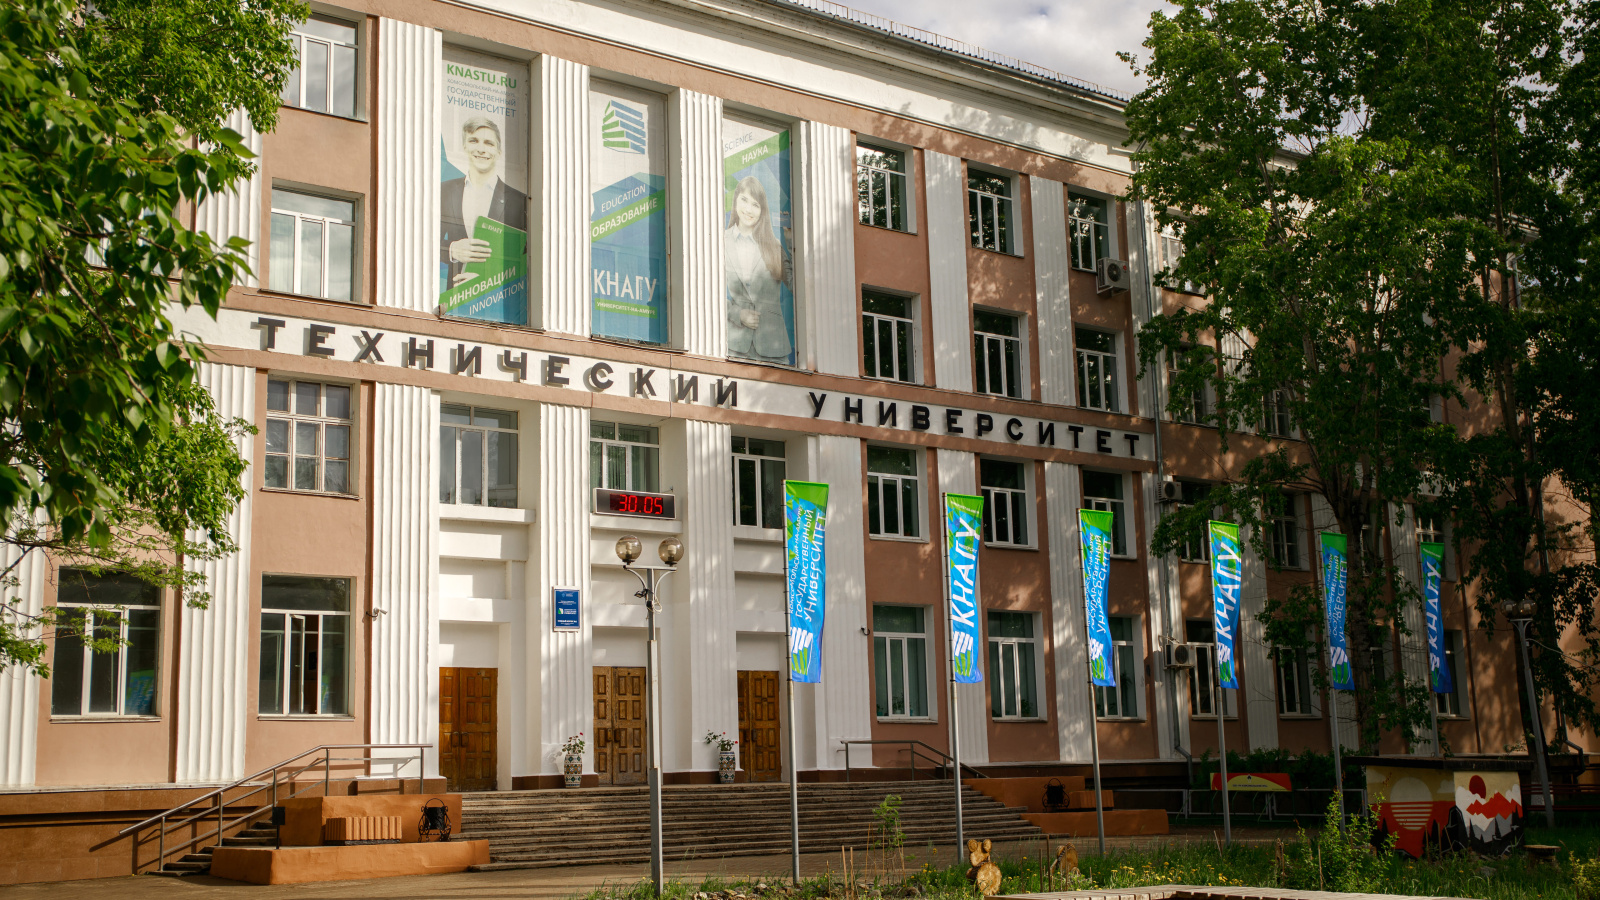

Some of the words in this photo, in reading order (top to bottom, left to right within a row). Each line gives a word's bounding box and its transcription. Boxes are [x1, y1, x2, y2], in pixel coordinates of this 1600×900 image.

[446, 63, 517, 89] KNASTU.RU
[446, 85, 516, 107] ГОСУДАРСТВЕННЫЙ
[446, 94, 517, 118] УНИВЕРСИТЕТ
[724, 131, 753, 153] SCIENCE
[741, 144, 769, 165] НАУКА
[601, 183, 646, 213] EDUCATION
[592, 197, 658, 238] ОБРАЗОВАНИЕ
[449, 265, 516, 307] ИННОВАЦИИ
[469, 280, 524, 316] INNOVATION
[593, 268, 657, 302] КНАГУ
[257, 316, 738, 407] ТЕХНИЧЕСКИЙ
[808, 391, 1140, 457] УНИВЕРСИТЕТ
[618, 493, 663, 515] 30.05
[795, 509, 814, 618] ГОСУДАРСТВЕННЫЙ
[803, 512, 826, 622] УНИВЕРСИТЕТ
[951, 516, 981, 628] КНАГУ
[1216, 541, 1241, 641] КНАГУ
[1426, 560, 1441, 650] КНАГУ
